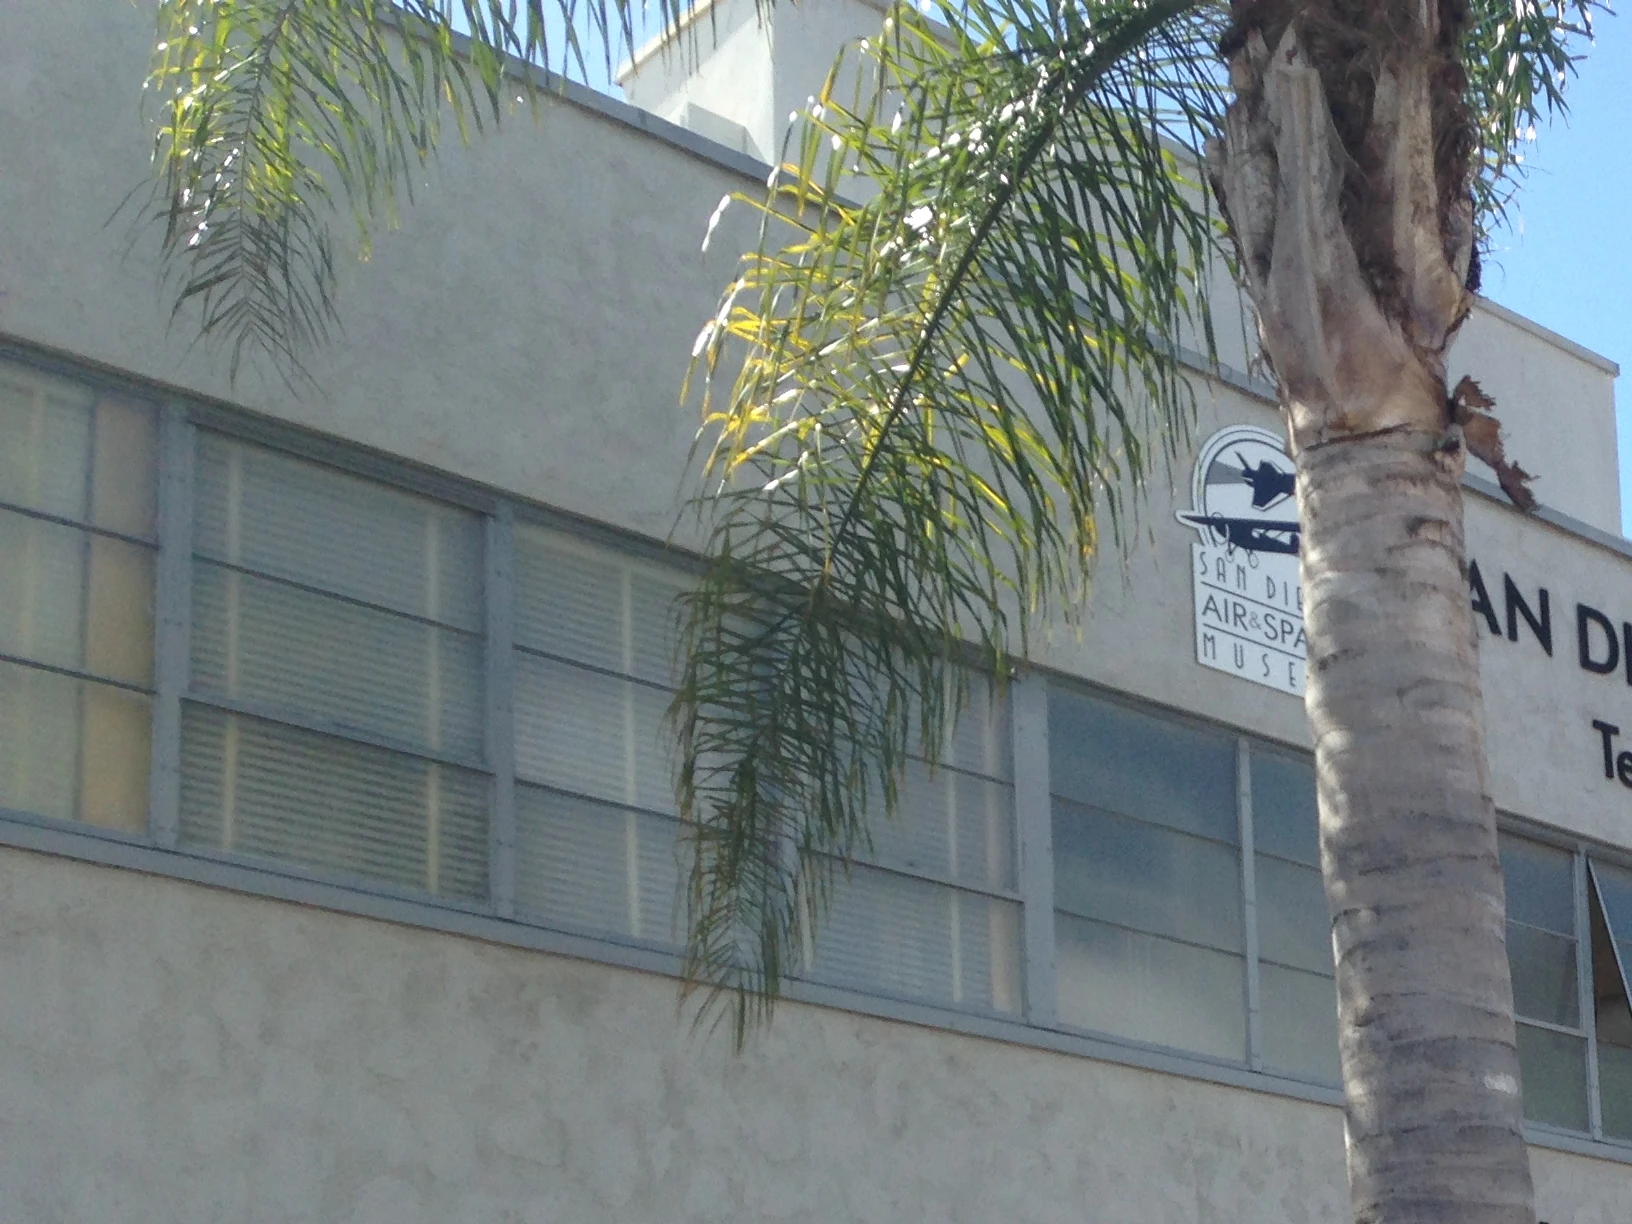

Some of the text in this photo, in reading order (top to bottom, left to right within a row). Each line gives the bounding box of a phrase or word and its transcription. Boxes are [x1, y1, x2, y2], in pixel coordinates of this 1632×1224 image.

[1200, 551, 1304, 611] SAN DIE
[1468, 558, 1553, 657] AN
[1202, 594, 1308, 648] AIR&SPA
[1203, 632, 1297, 688] MUSE
